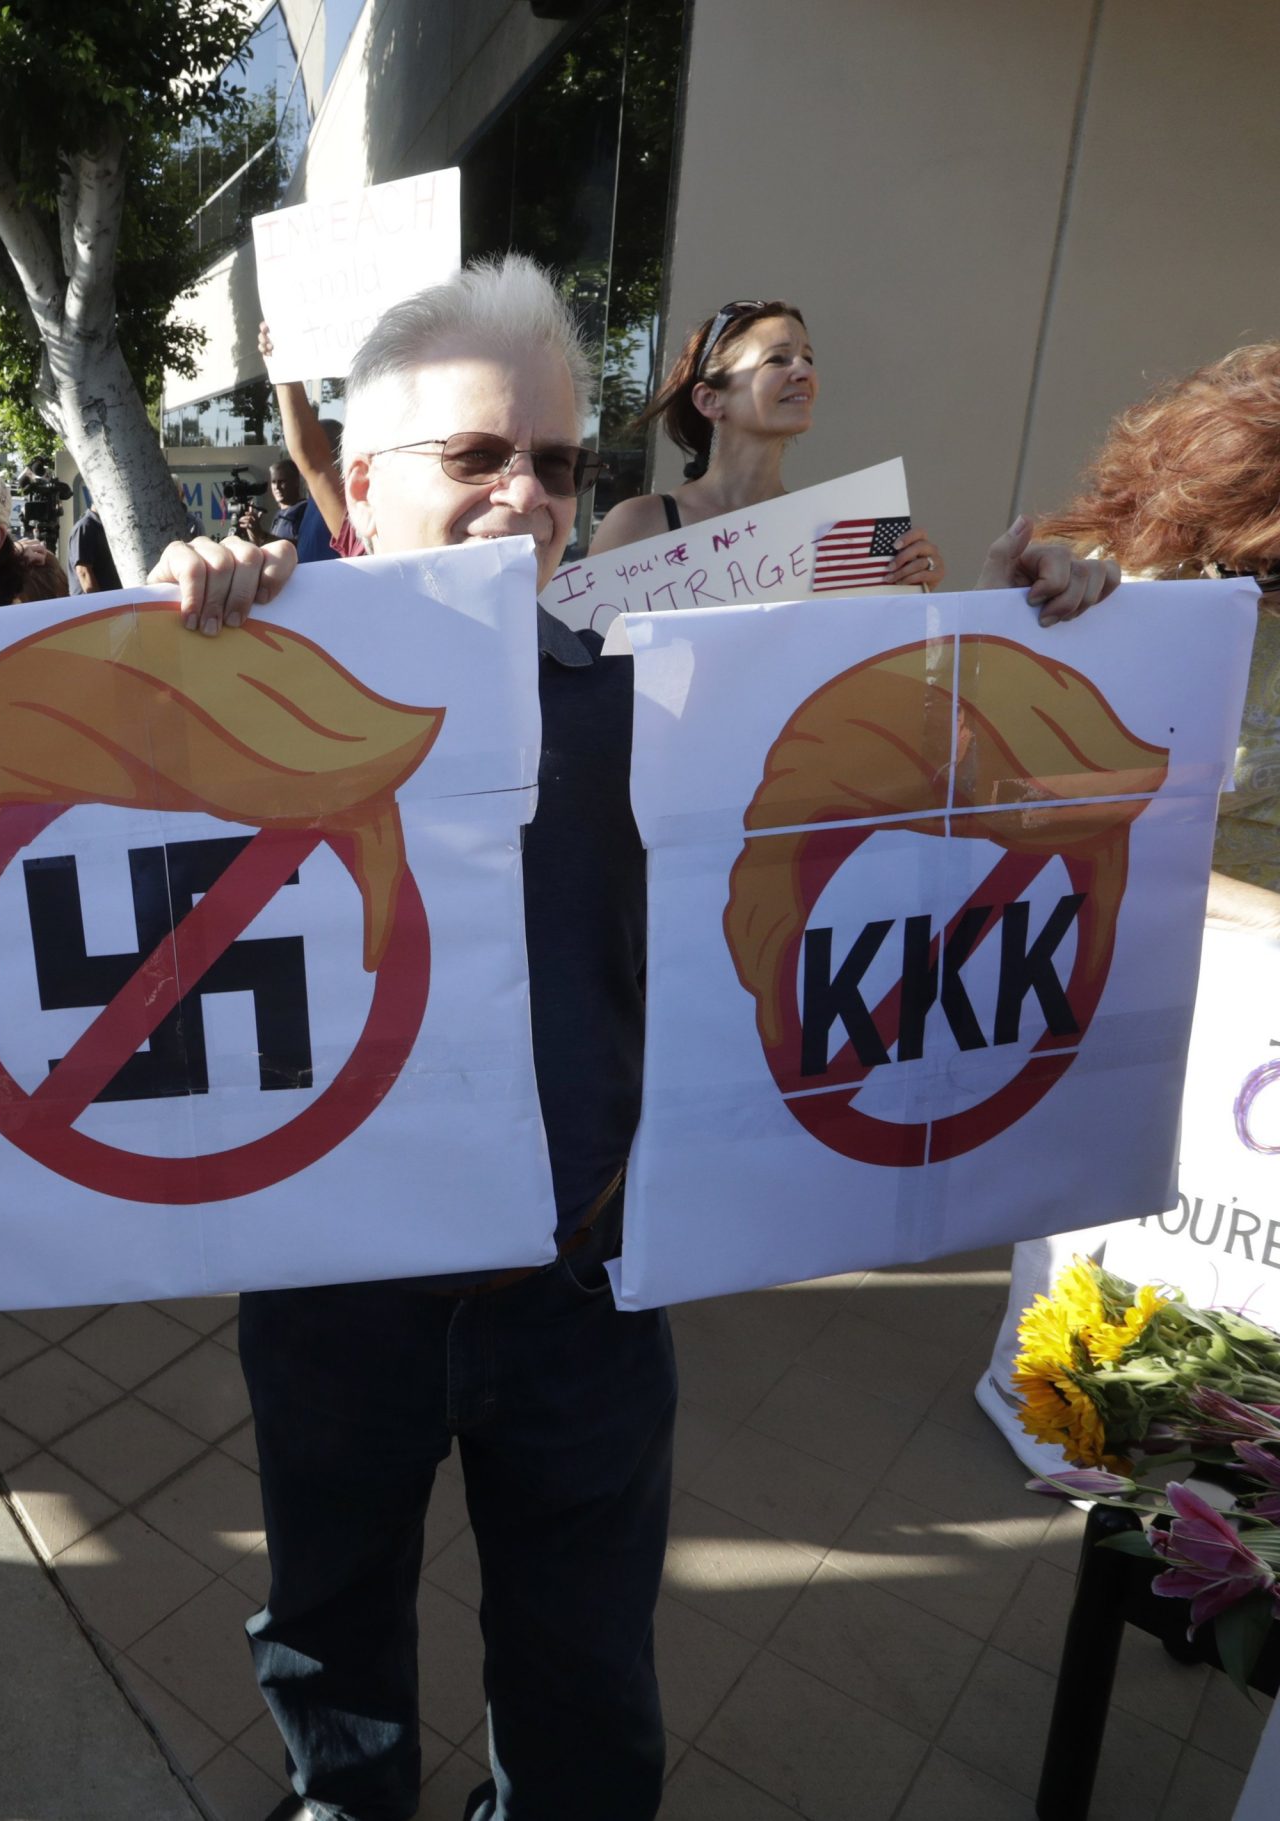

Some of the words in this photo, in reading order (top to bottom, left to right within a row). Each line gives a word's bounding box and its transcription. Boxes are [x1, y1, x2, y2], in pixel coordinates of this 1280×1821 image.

[590, 542, 818, 630] OTRAGE
[800, 892, 1089, 1078] KKK
[1138, 1191, 1280, 1270] OU'RE
